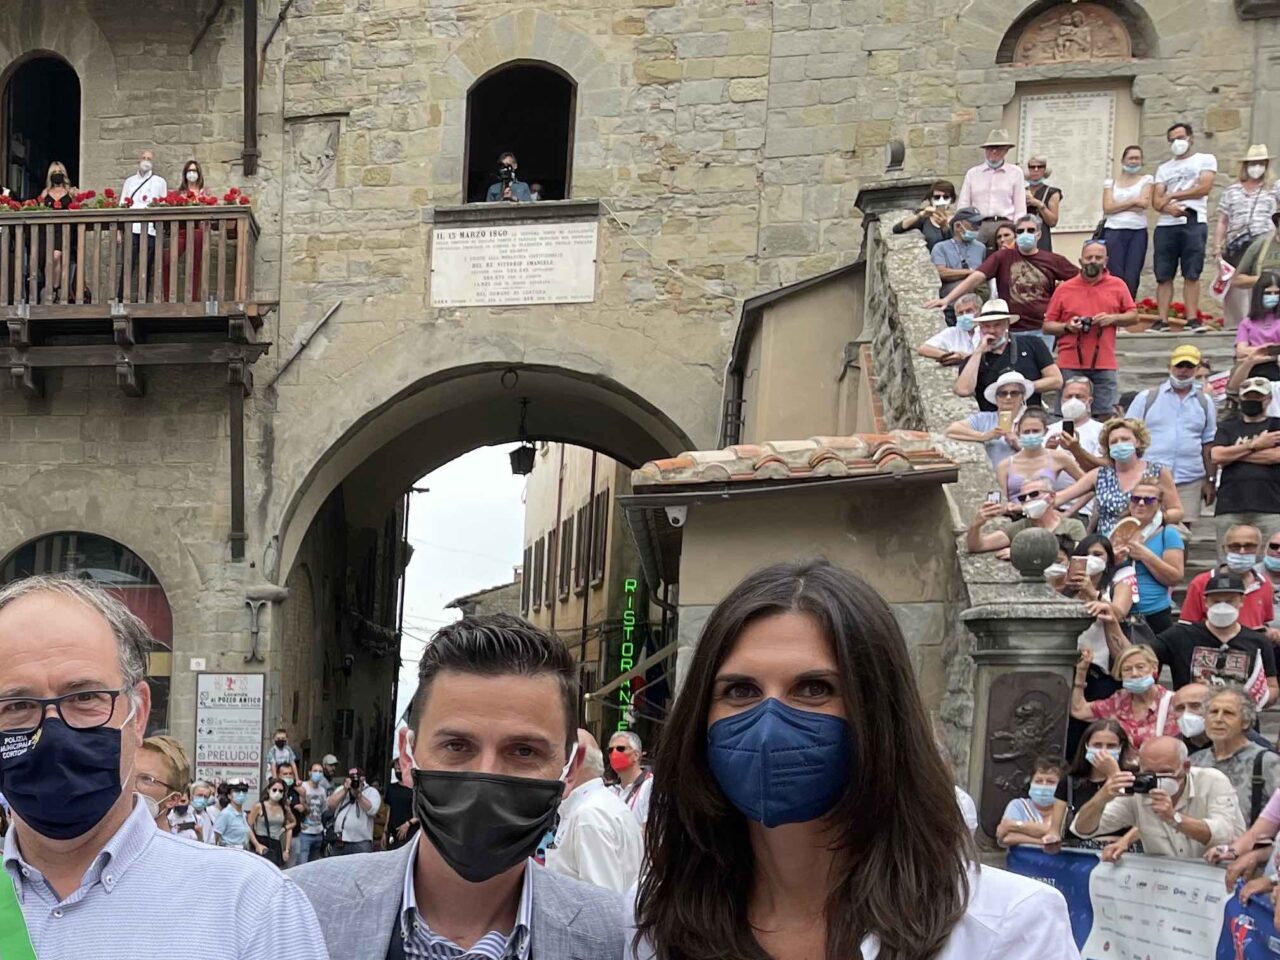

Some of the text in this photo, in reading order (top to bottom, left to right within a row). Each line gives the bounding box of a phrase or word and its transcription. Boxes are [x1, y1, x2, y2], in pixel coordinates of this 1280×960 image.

[459, 231, 486, 239] MARZO
[4, 735, 28, 744] POLIZIA
[207, 750, 259, 761] PRELUDIO
